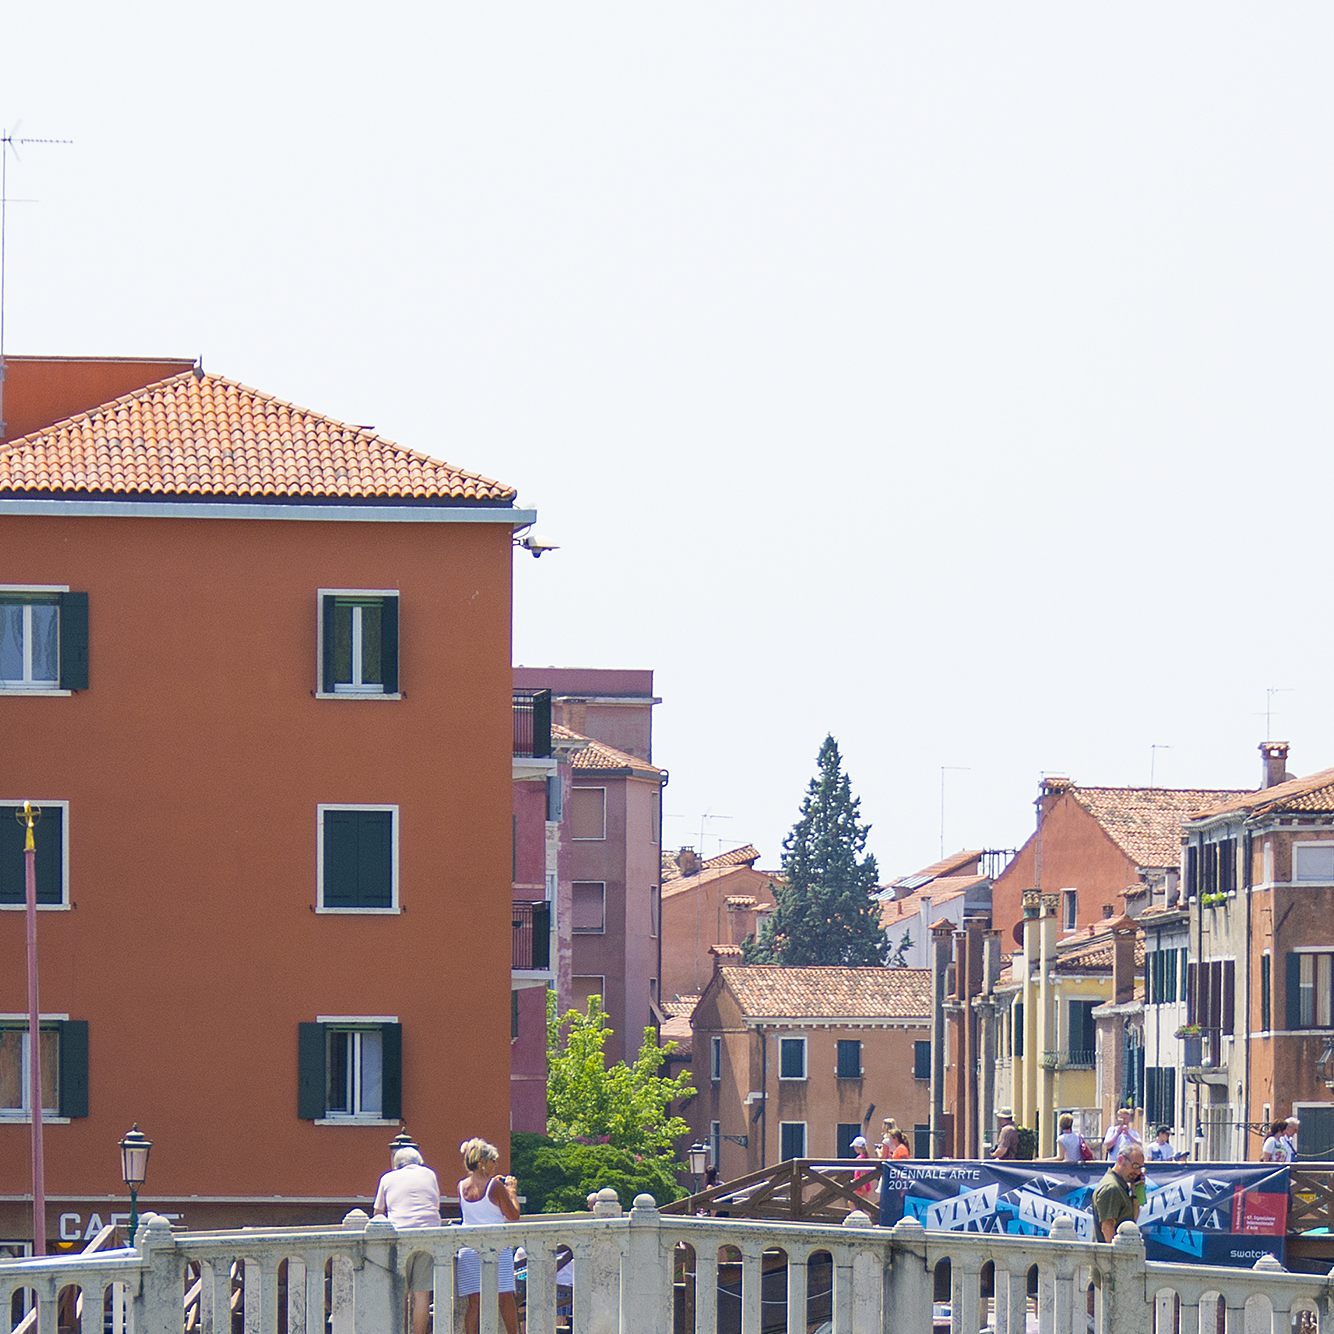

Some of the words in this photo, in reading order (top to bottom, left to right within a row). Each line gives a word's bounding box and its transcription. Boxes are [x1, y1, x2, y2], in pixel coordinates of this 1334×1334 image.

[889, 1168, 946, 1180] BIENNALE
[949, 1169, 980, 1180] ARTE
[888, 1180, 916, 1190] 2017
[933, 1191, 990, 1227] VIVA
[1230, 1249, 1268, 1259] swatch
